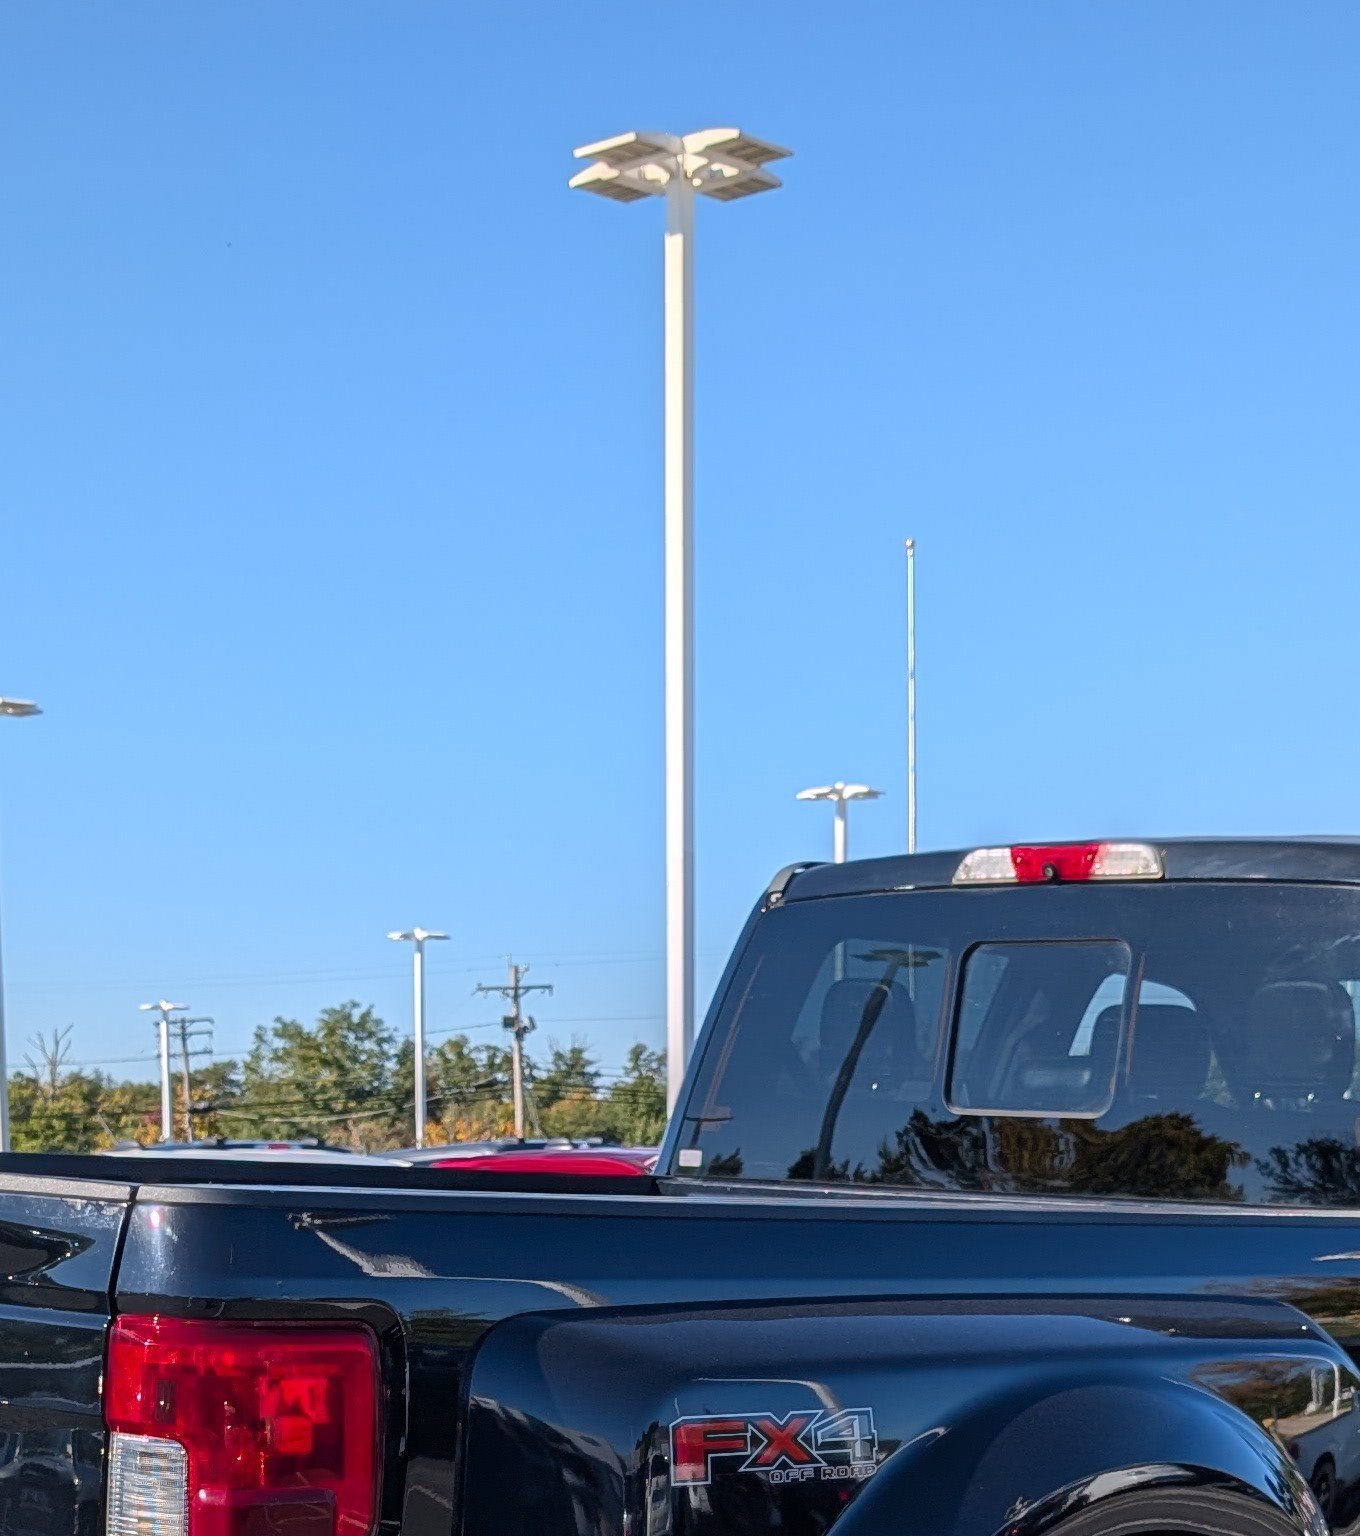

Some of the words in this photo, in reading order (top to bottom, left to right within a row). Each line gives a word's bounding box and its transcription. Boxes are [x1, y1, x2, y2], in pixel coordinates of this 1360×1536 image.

[669, 1407, 879, 1487] FX4
[769, 1468, 815, 1484] OFF
[821, 1463, 878, 1480] ROAD
